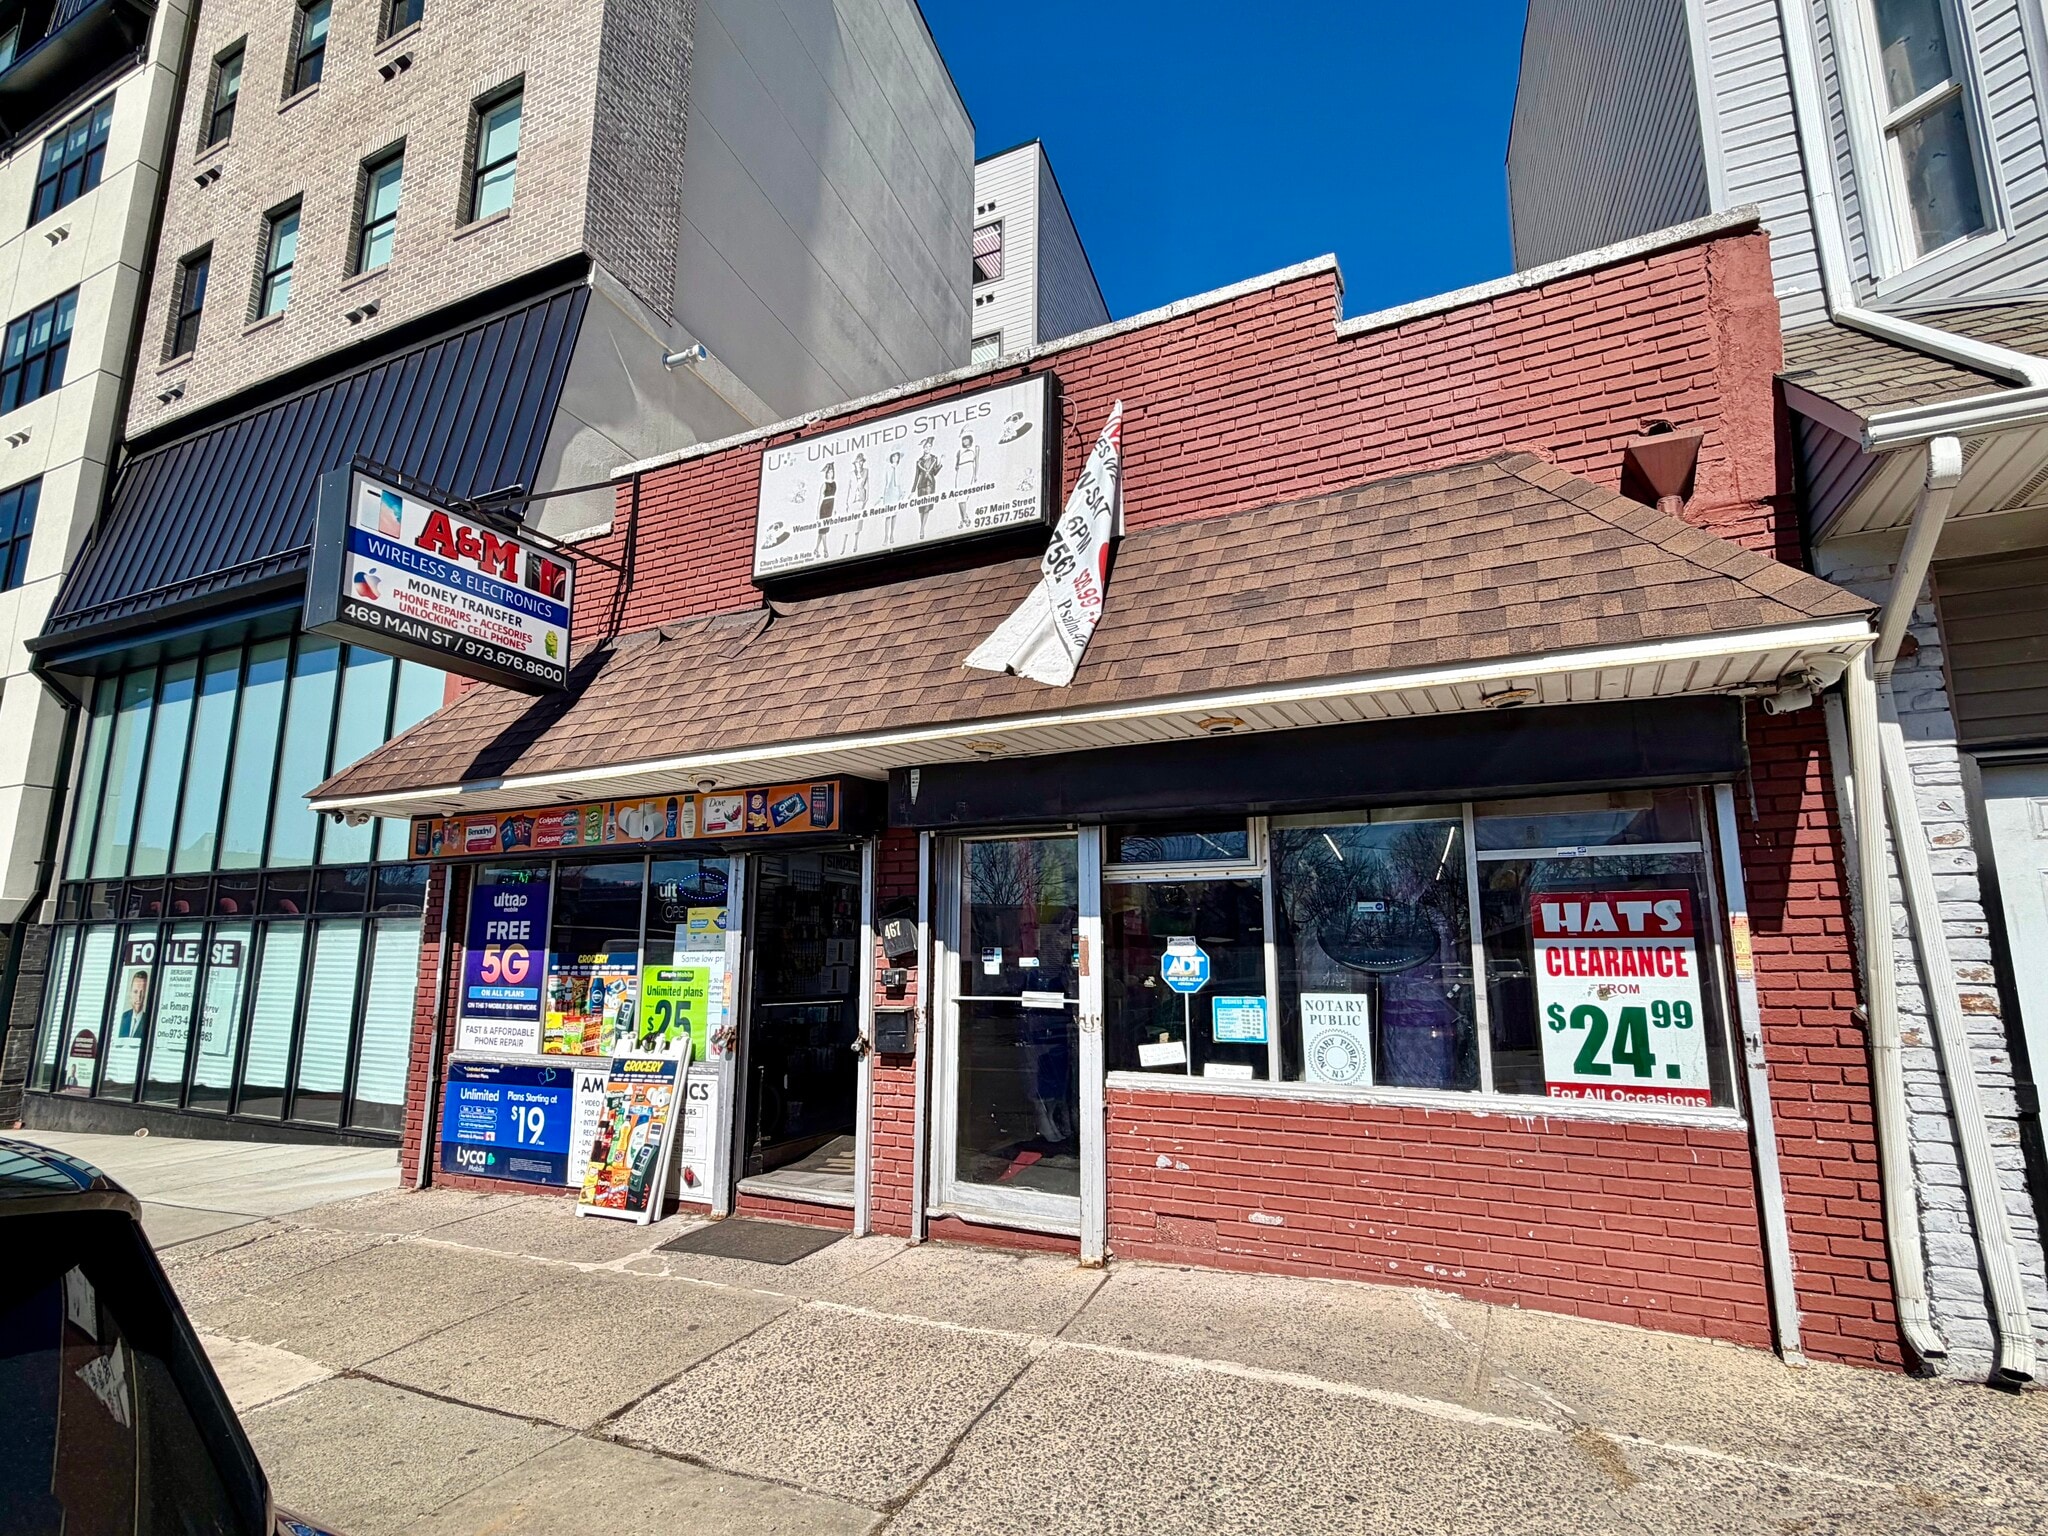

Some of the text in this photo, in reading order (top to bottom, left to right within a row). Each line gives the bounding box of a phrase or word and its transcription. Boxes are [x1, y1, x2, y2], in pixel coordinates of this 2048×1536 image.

[807, 424, 908, 462] UNLIMITED
[913, 401, 992, 434] STYLES
[792, 482, 995, 534] Women's Wholesaler & Retailer for Clothing & Accessories
[974, 495, 1036, 516] 467 Main Street
[974, 506, 1036, 528] 973.677.7562
[1065, 515, 1092, 555] 6PM
[415, 509, 520, 583] A&M
[367, 537, 553, 618] WIRELESS & ELECTRONICS
[407, 578, 522, 628] MONEY TRANSFER
[393, 588, 533, 644] PHONE REPAIRS ACCESORIES
[398, 602, 527, 652] UNLOCKING CELL PHONES
[343, 603, 382, 626] 469
[384, 614, 429, 643] MAIN
[431, 628, 454, 649] ST
[465, 641, 563, 683] 973.676.8600
[708, 797, 727, 808] Dove
[538, 815, 562, 825] Colgate
[467, 826, 493, 837] Benadryl
[537, 835, 562, 845] Colgate
[1540, 899, 1683, 933] HATS
[486, 920, 531, 940] FREE
[884, 920, 901, 940] 467
[480, 942, 530, 984] 5G
[577, 953, 610, 965] GROCERY
[681, 954, 700, 963] Same
[701, 954, 714, 963] low
[1166, 956, 1205, 976] ADT
[1545, 945, 1690, 978] CLEARANCE
[481, 989, 491, 997] ON
[504, 989, 525, 998] PLANS
[647, 985, 682, 998] Unlimited
[683, 986, 704, 999] plans
[1598, 983, 1641, 995] FROM
[513, 1003, 537, 1011] NETWORK
[1304, 999, 1365, 1012] NOTARY
[1309, 1014, 1361, 1027] PUBLIC
[465, 1025, 535, 1038] FAST & AFFORDABLE
[474, 1036, 524, 1047] PHONE REPAIR
[1317, 1037, 1358, 1071] NOTARY PUBLIC
[623, 1060, 664, 1072] GROCERY
[1331, 1070, 1345, 1079] NJ
[460, 1087, 500, 1102] Unlimited
[507, 1090, 558, 1106] Plans Starting at
[1550, 1085, 1708, 1108] For All Occasions
[511, 1105, 545, 1144] $19
[456, 1145, 486, 1166] Lyca
[467, 1165, 485, 1173] Mobile
